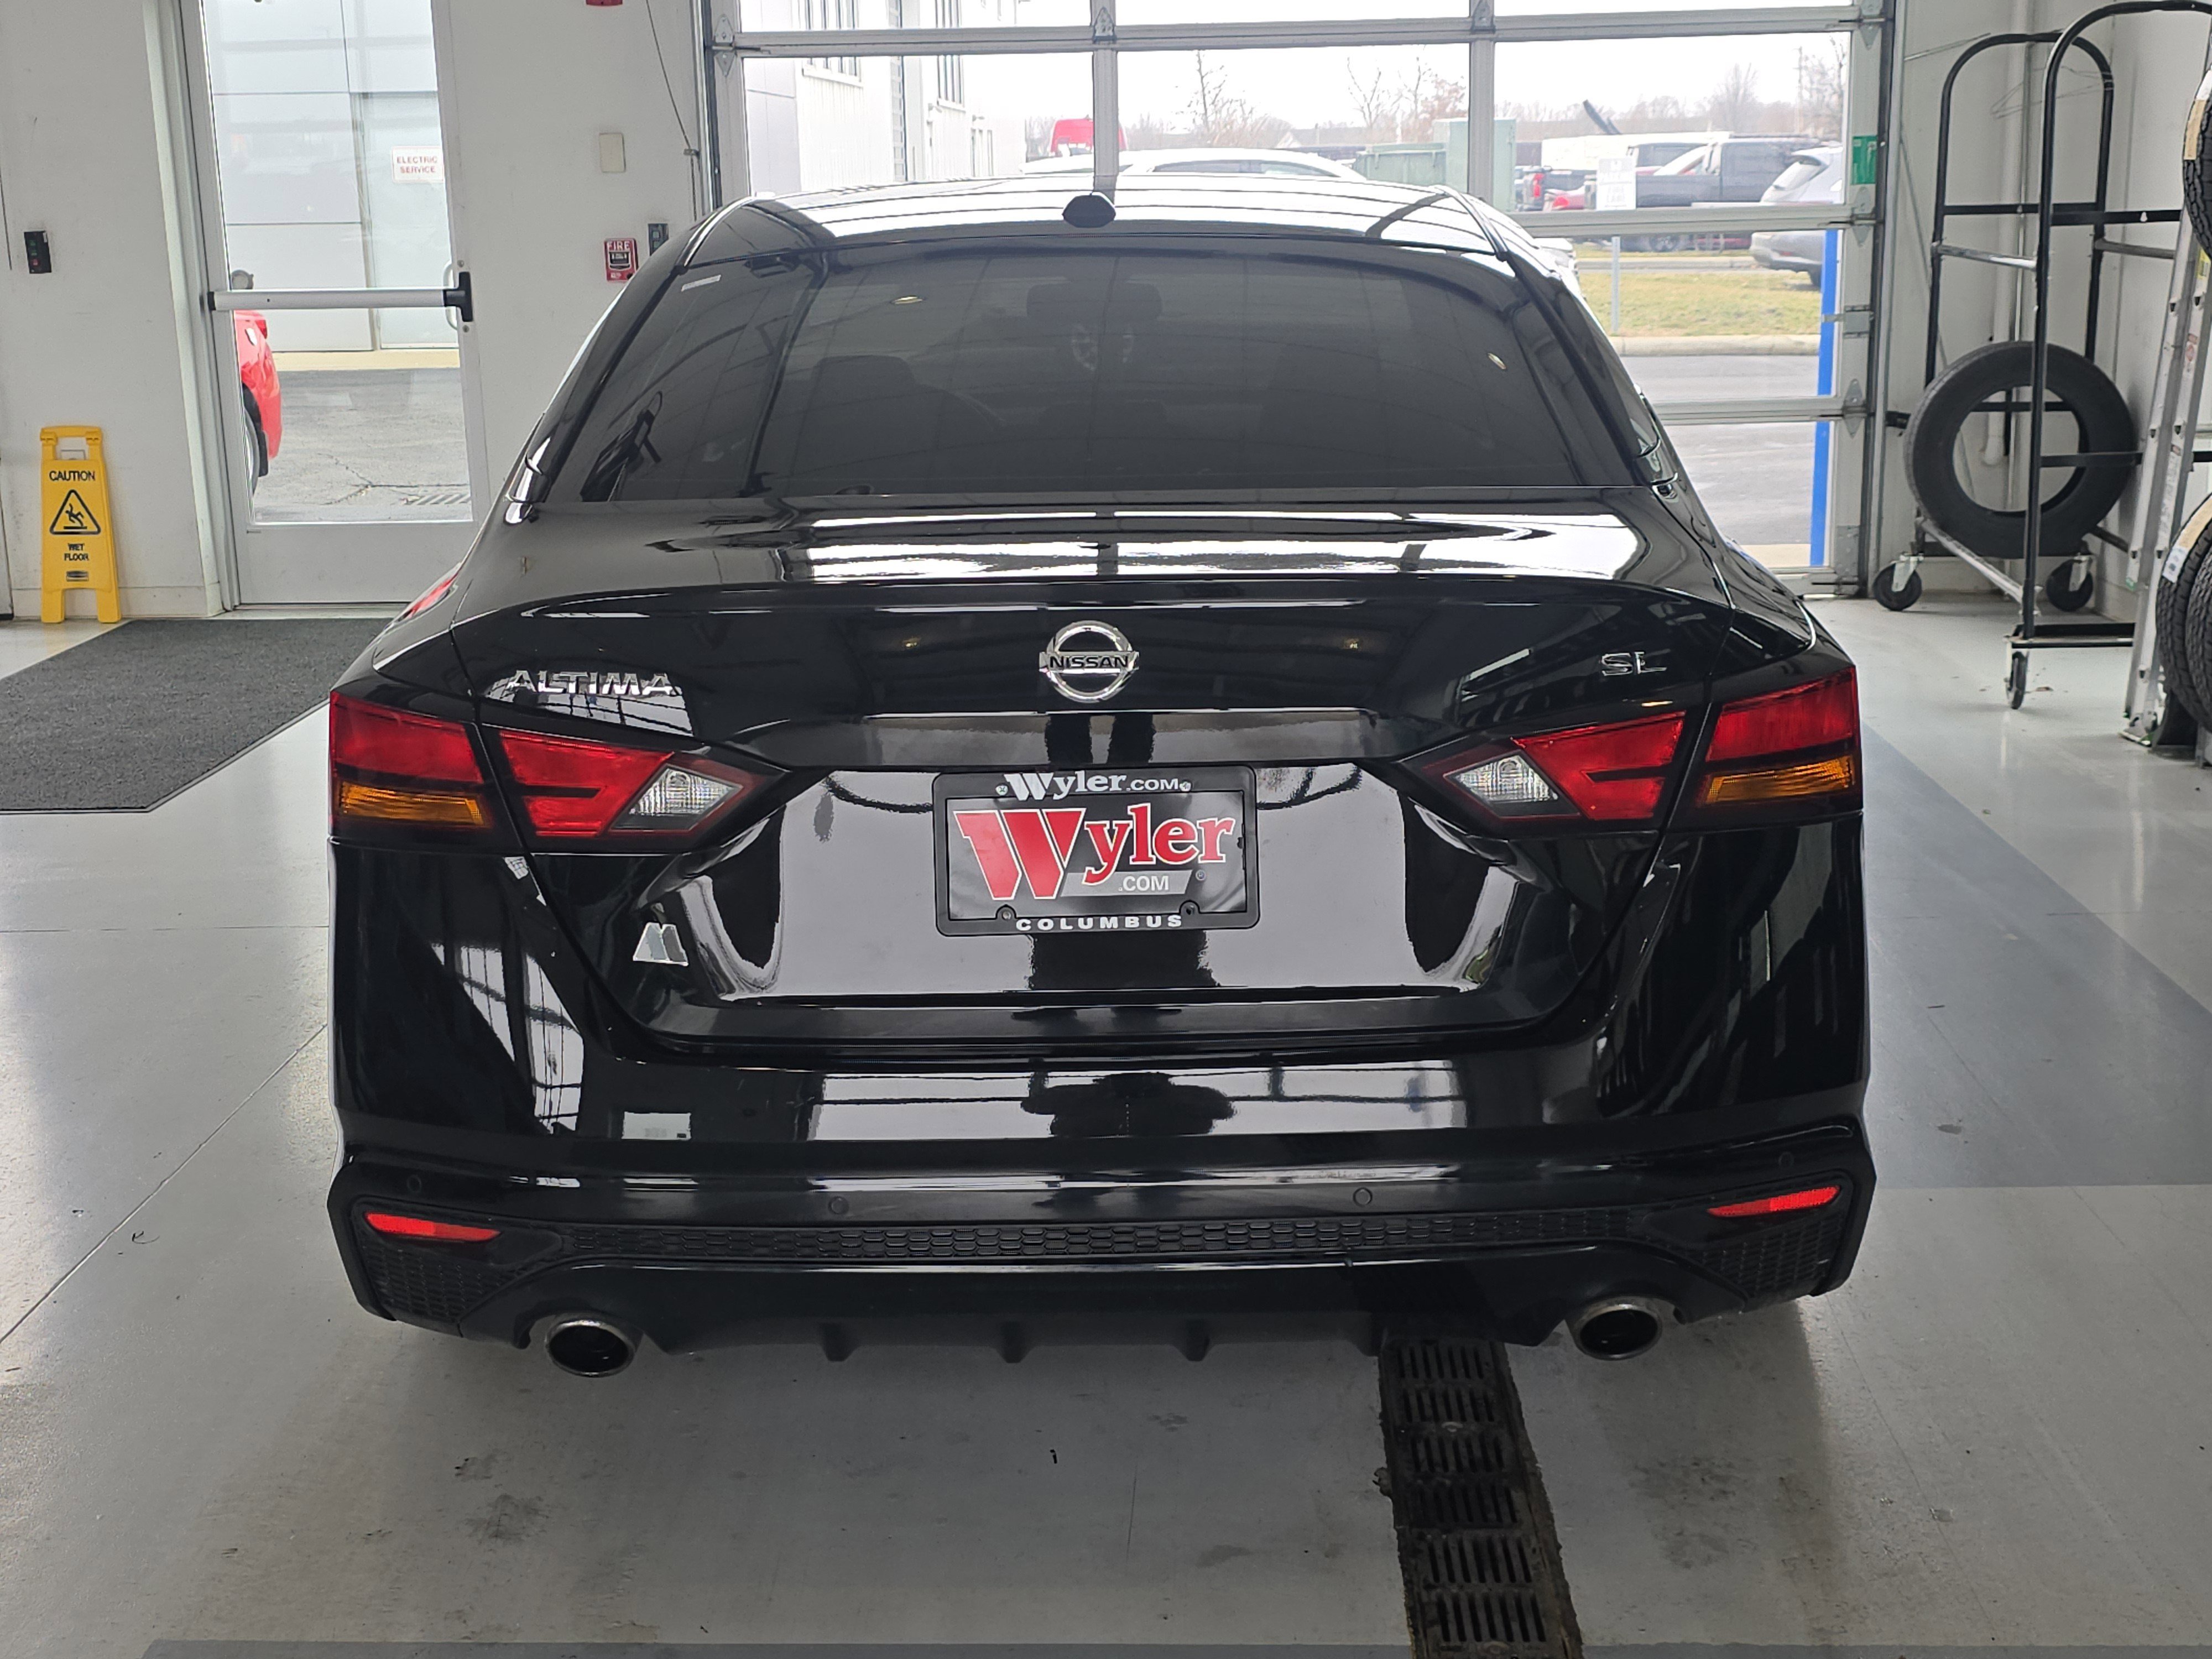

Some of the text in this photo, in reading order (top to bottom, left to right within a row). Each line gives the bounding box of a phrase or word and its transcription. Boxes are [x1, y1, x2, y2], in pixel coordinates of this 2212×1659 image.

[607, 241, 630, 250] FIRE
[49, 471, 95, 481] CAUTION
[64, 553, 89, 561] FLOOR
[1050, 655, 1128, 668] NISSAN
[1601, 651, 1667, 676] SL
[505, 670, 673, 695] ALTIMA
[953, 802, 1235, 901] Wyler
[1016, 914, 1182, 931] COLUMBUS
